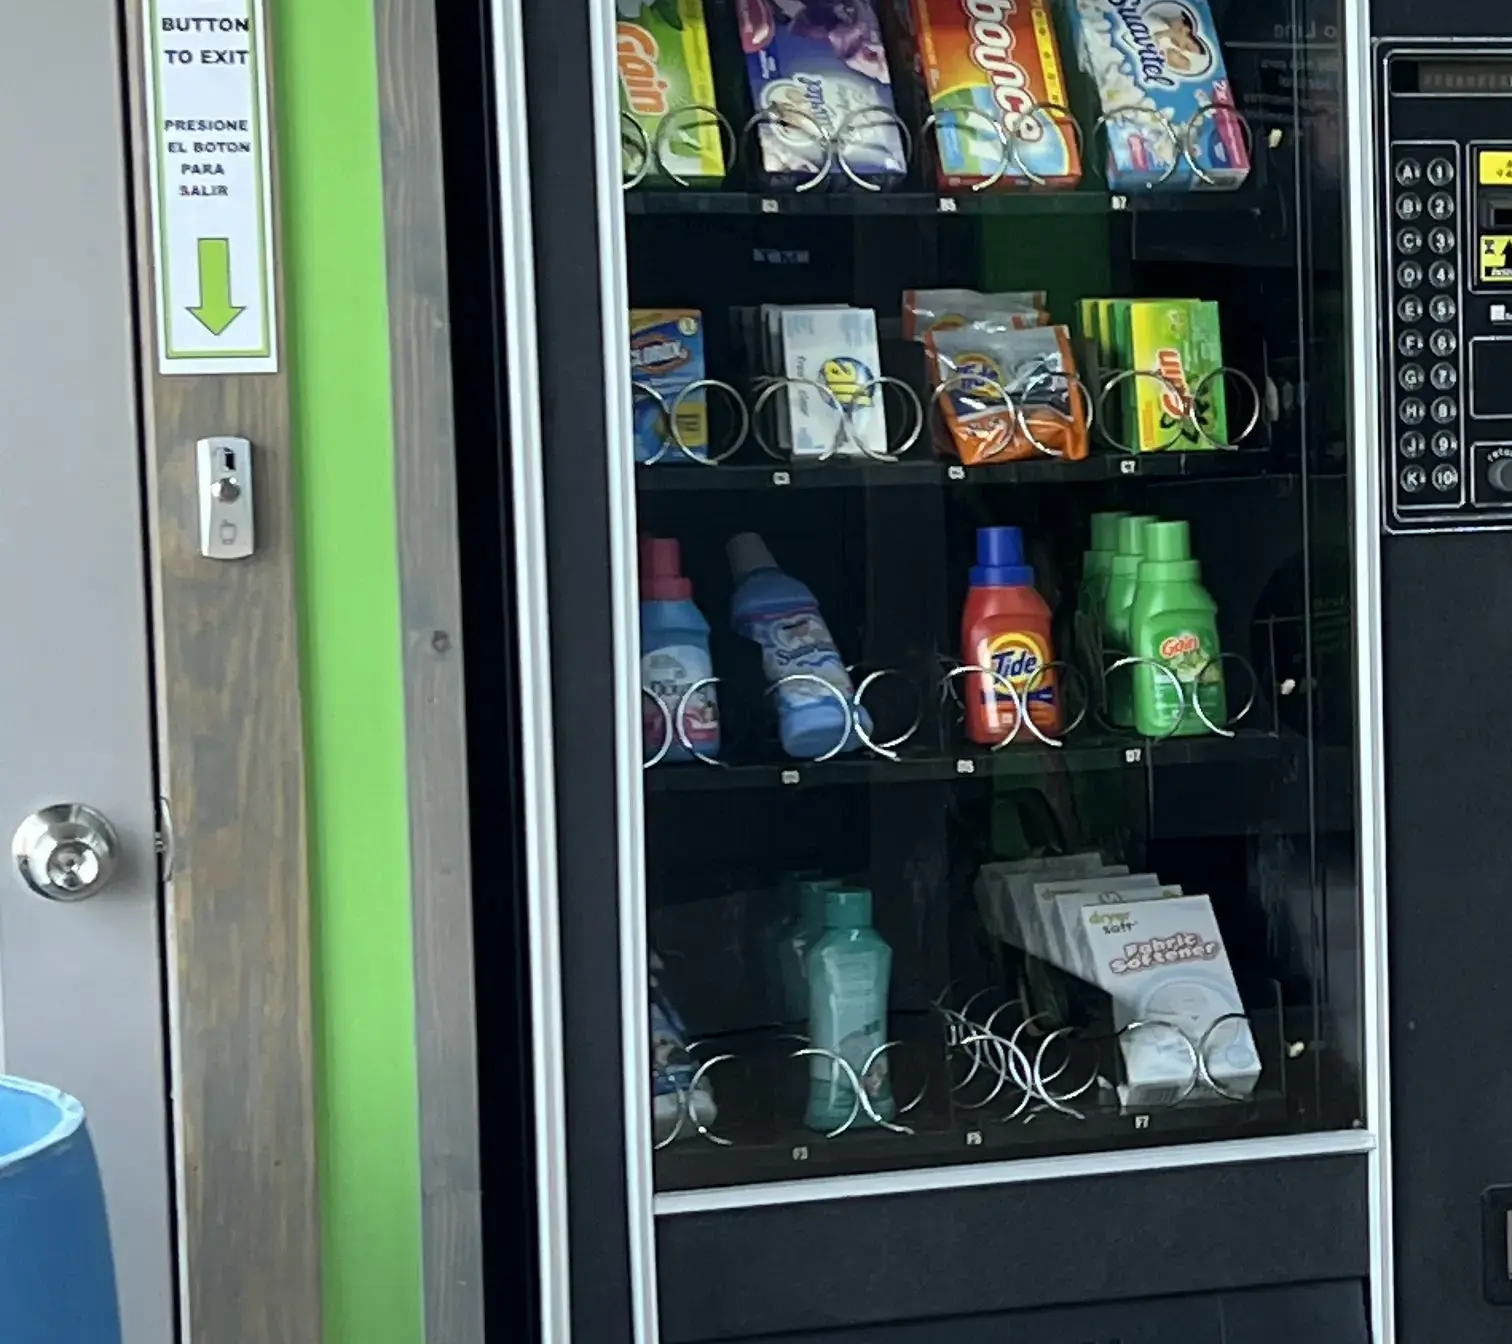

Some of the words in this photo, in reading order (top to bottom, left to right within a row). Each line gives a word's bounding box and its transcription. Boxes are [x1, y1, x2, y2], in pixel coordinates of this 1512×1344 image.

[162, 18, 249, 32] BUTTON
[164, 51, 193, 65] TO
[201, 50, 249, 65] EXIT
[164, 120, 248, 132] PRESIONE
[168, 142, 188, 153] EL
[194, 141, 250, 154] BOTON
[181, 164, 224, 175] PARA
[1162, 635, 1199, 655] Gain
[993, 649, 1037, 683] Tide
[1123, 933, 1202, 957] Fabric
[1109, 942, 1219, 974] Softener
